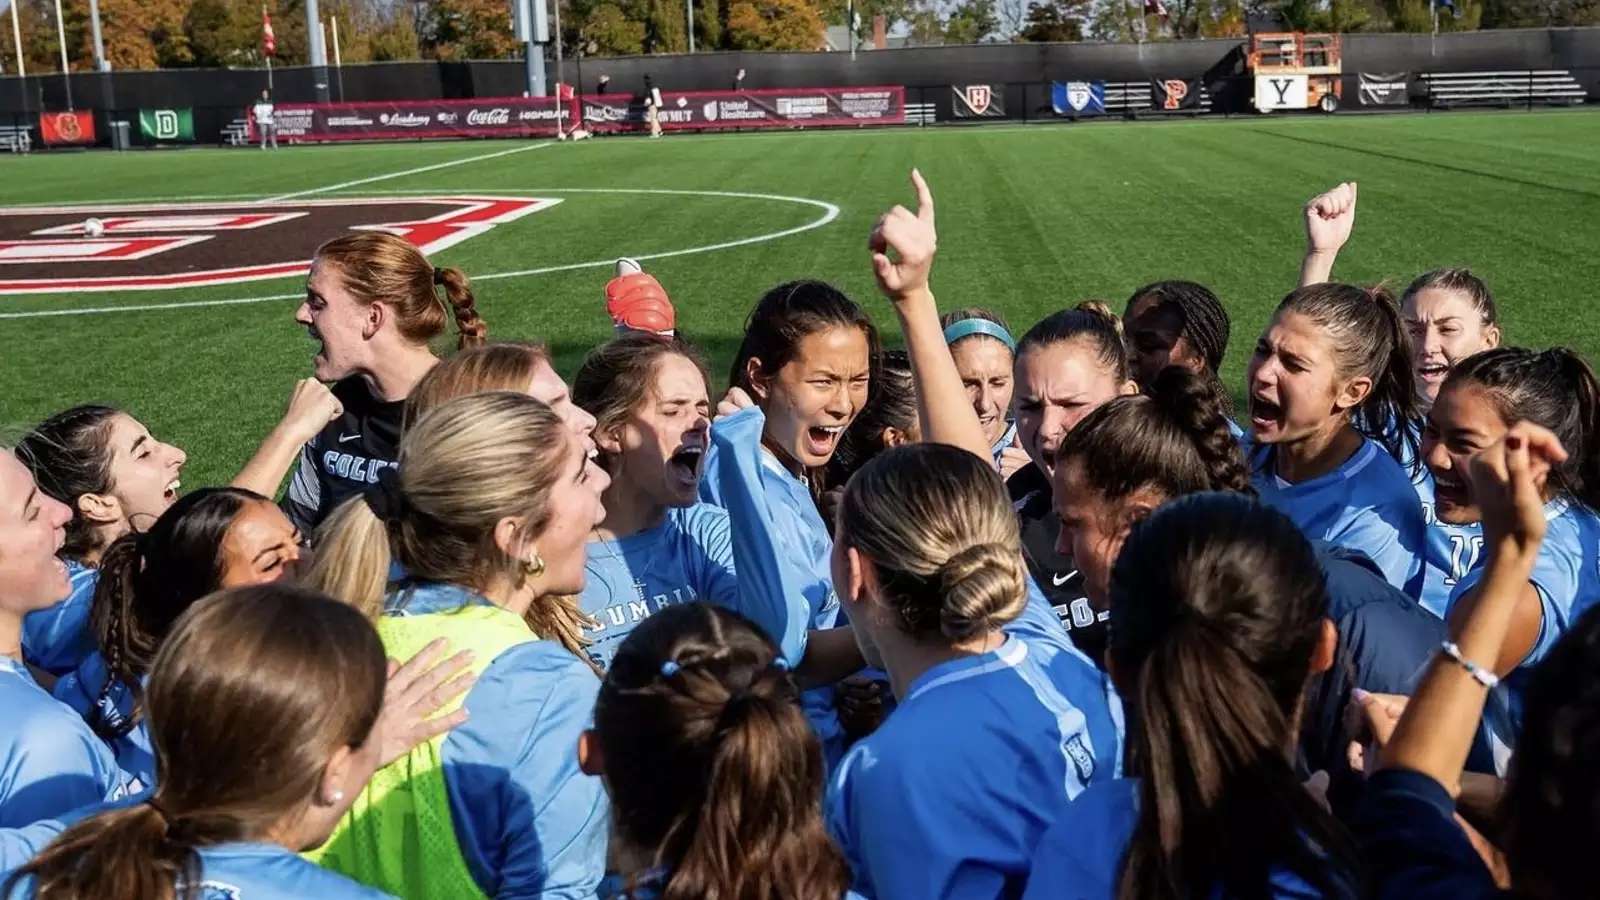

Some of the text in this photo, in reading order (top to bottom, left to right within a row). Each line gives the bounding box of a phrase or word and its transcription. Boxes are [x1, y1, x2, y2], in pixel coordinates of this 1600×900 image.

[719, 100, 748, 110] United
[1269, 79, 1295, 105] Y
[154, 109, 179, 139] D
